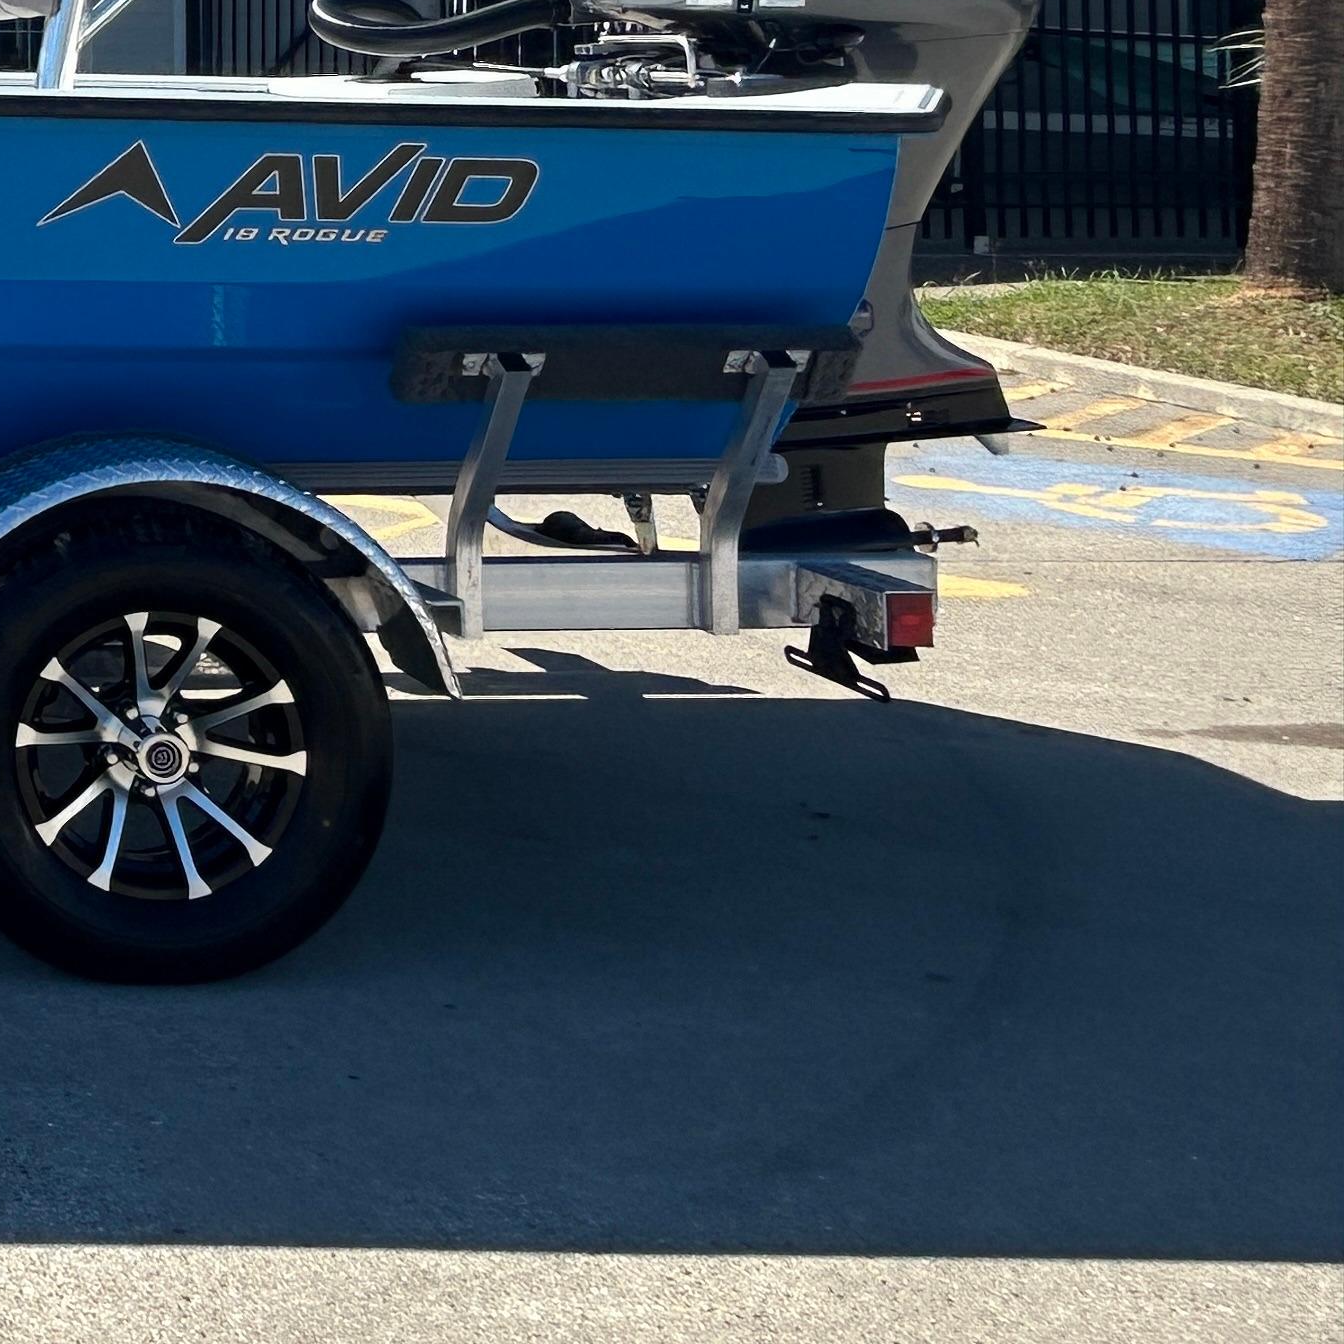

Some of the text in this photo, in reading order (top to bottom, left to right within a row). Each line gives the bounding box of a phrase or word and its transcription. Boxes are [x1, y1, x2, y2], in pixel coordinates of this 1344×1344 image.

[173, 142, 541, 245] AVID
[223, 227, 389, 246] 18 ROGUE
